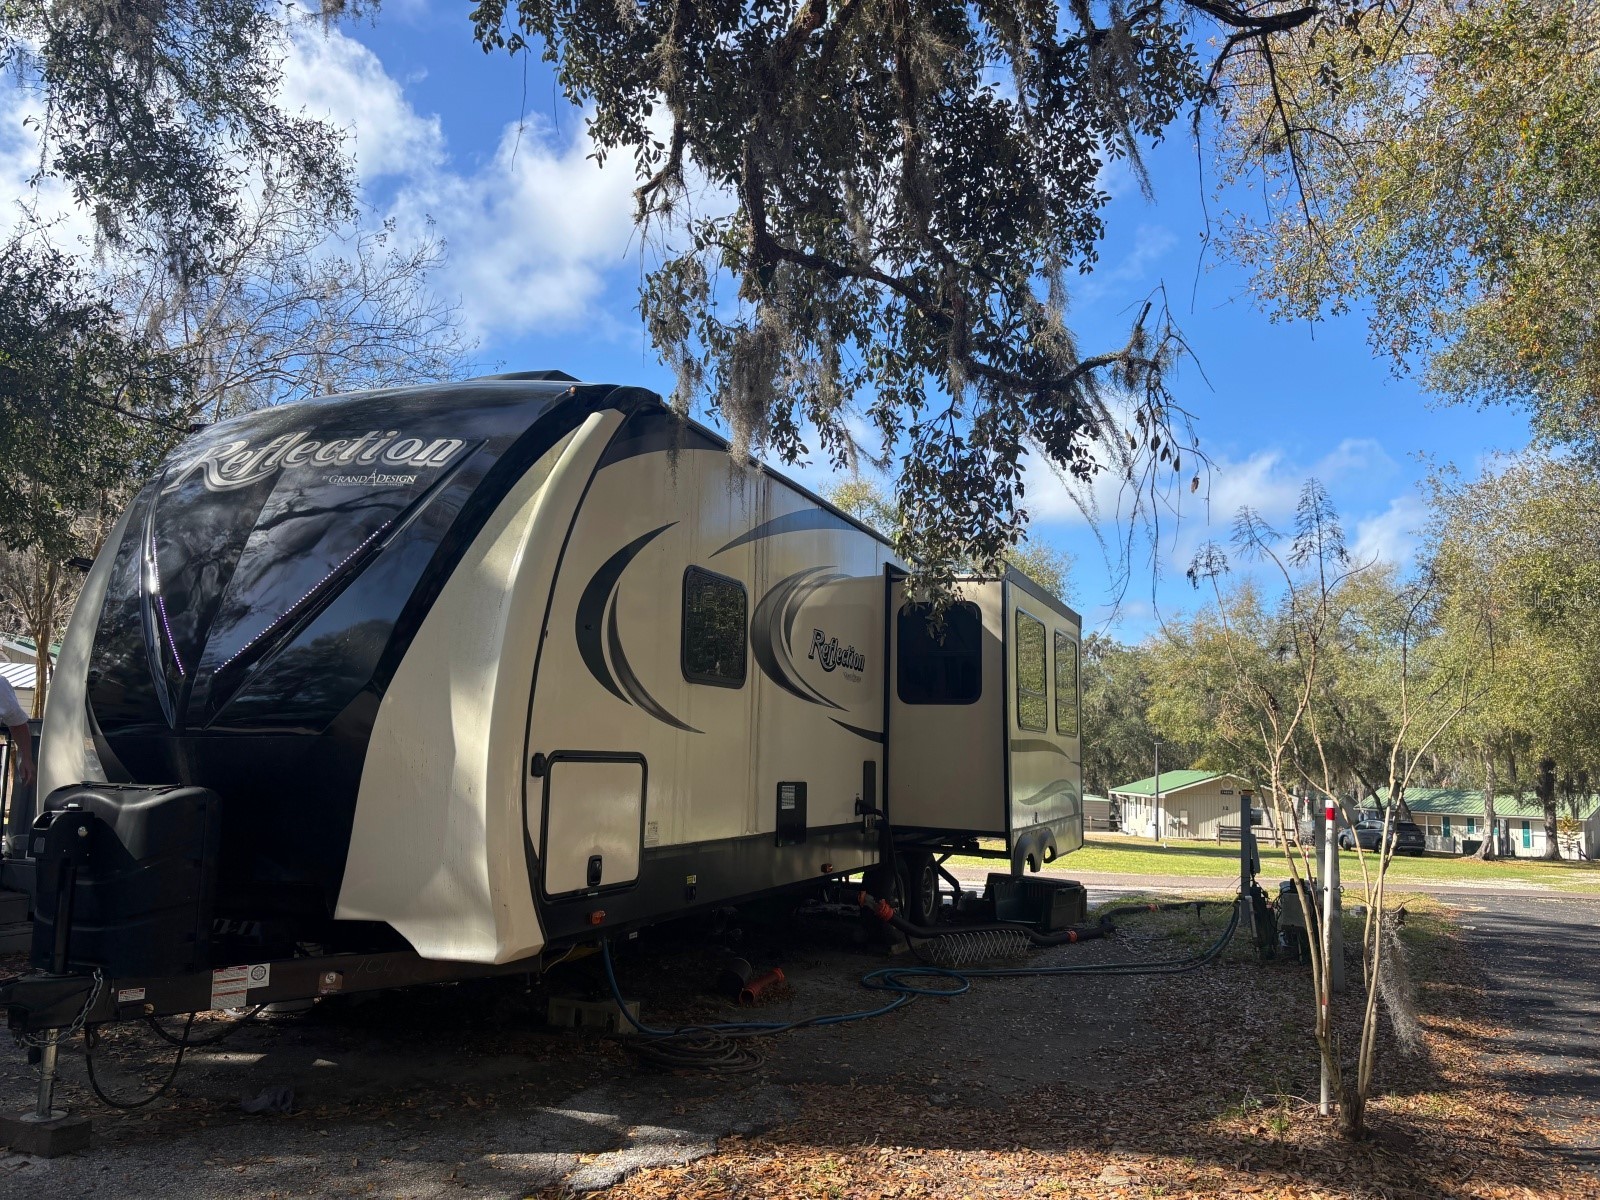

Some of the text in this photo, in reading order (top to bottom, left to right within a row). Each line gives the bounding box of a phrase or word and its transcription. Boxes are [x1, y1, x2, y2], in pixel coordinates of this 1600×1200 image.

[160, 427, 467, 493] Reflection
[328, 474, 368, 483] GRAND
[376, 474, 417, 483] DESIGN
[808, 628, 866, 672] Reflection
